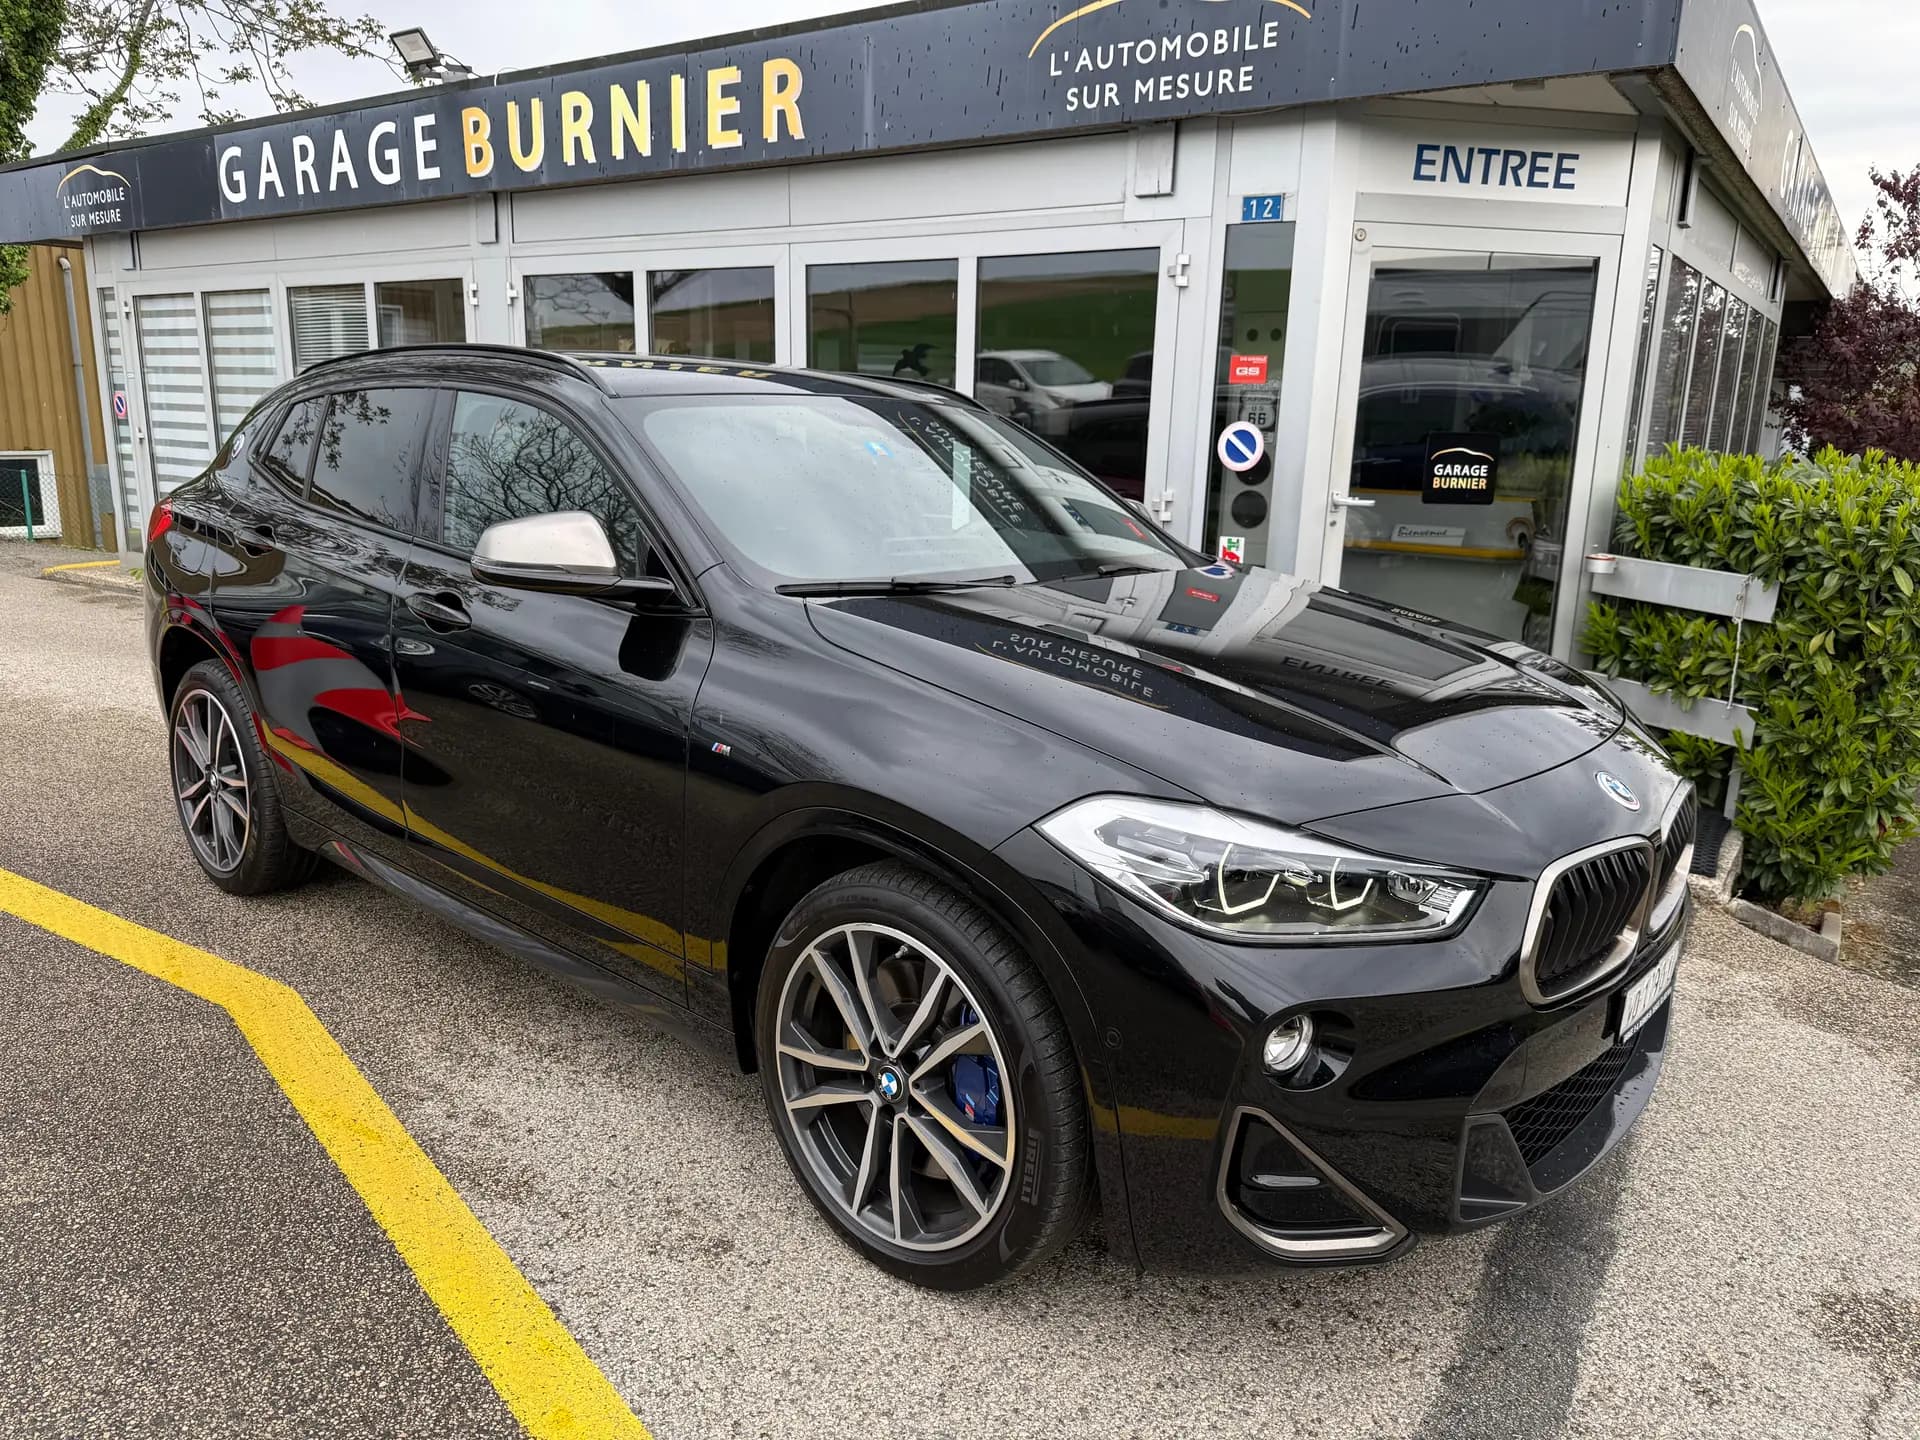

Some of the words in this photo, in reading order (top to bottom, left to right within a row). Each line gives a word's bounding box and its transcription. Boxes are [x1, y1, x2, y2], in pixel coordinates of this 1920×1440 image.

[1050, 21, 1279, 77] L'AUTOMOBILE
[1066, 83, 1120, 111] SUR
[1134, 66, 1254, 104] MESURE
[219, 113, 441, 203] GARAGE
[461, 57, 805, 178] BURNIER
[1413, 144, 1580, 190] ENTREE
[63, 187, 125, 209] L'AUTOMOBILE
[1249, 198, 1273, 219] 12
[70, 213, 87, 228] SUR
[88, 208, 122, 226] MESURE
[1236, 366, 1260, 377] GS
[1434, 463, 1489, 477] GARAGE
[1432, 476, 1487, 490] BURNIER
